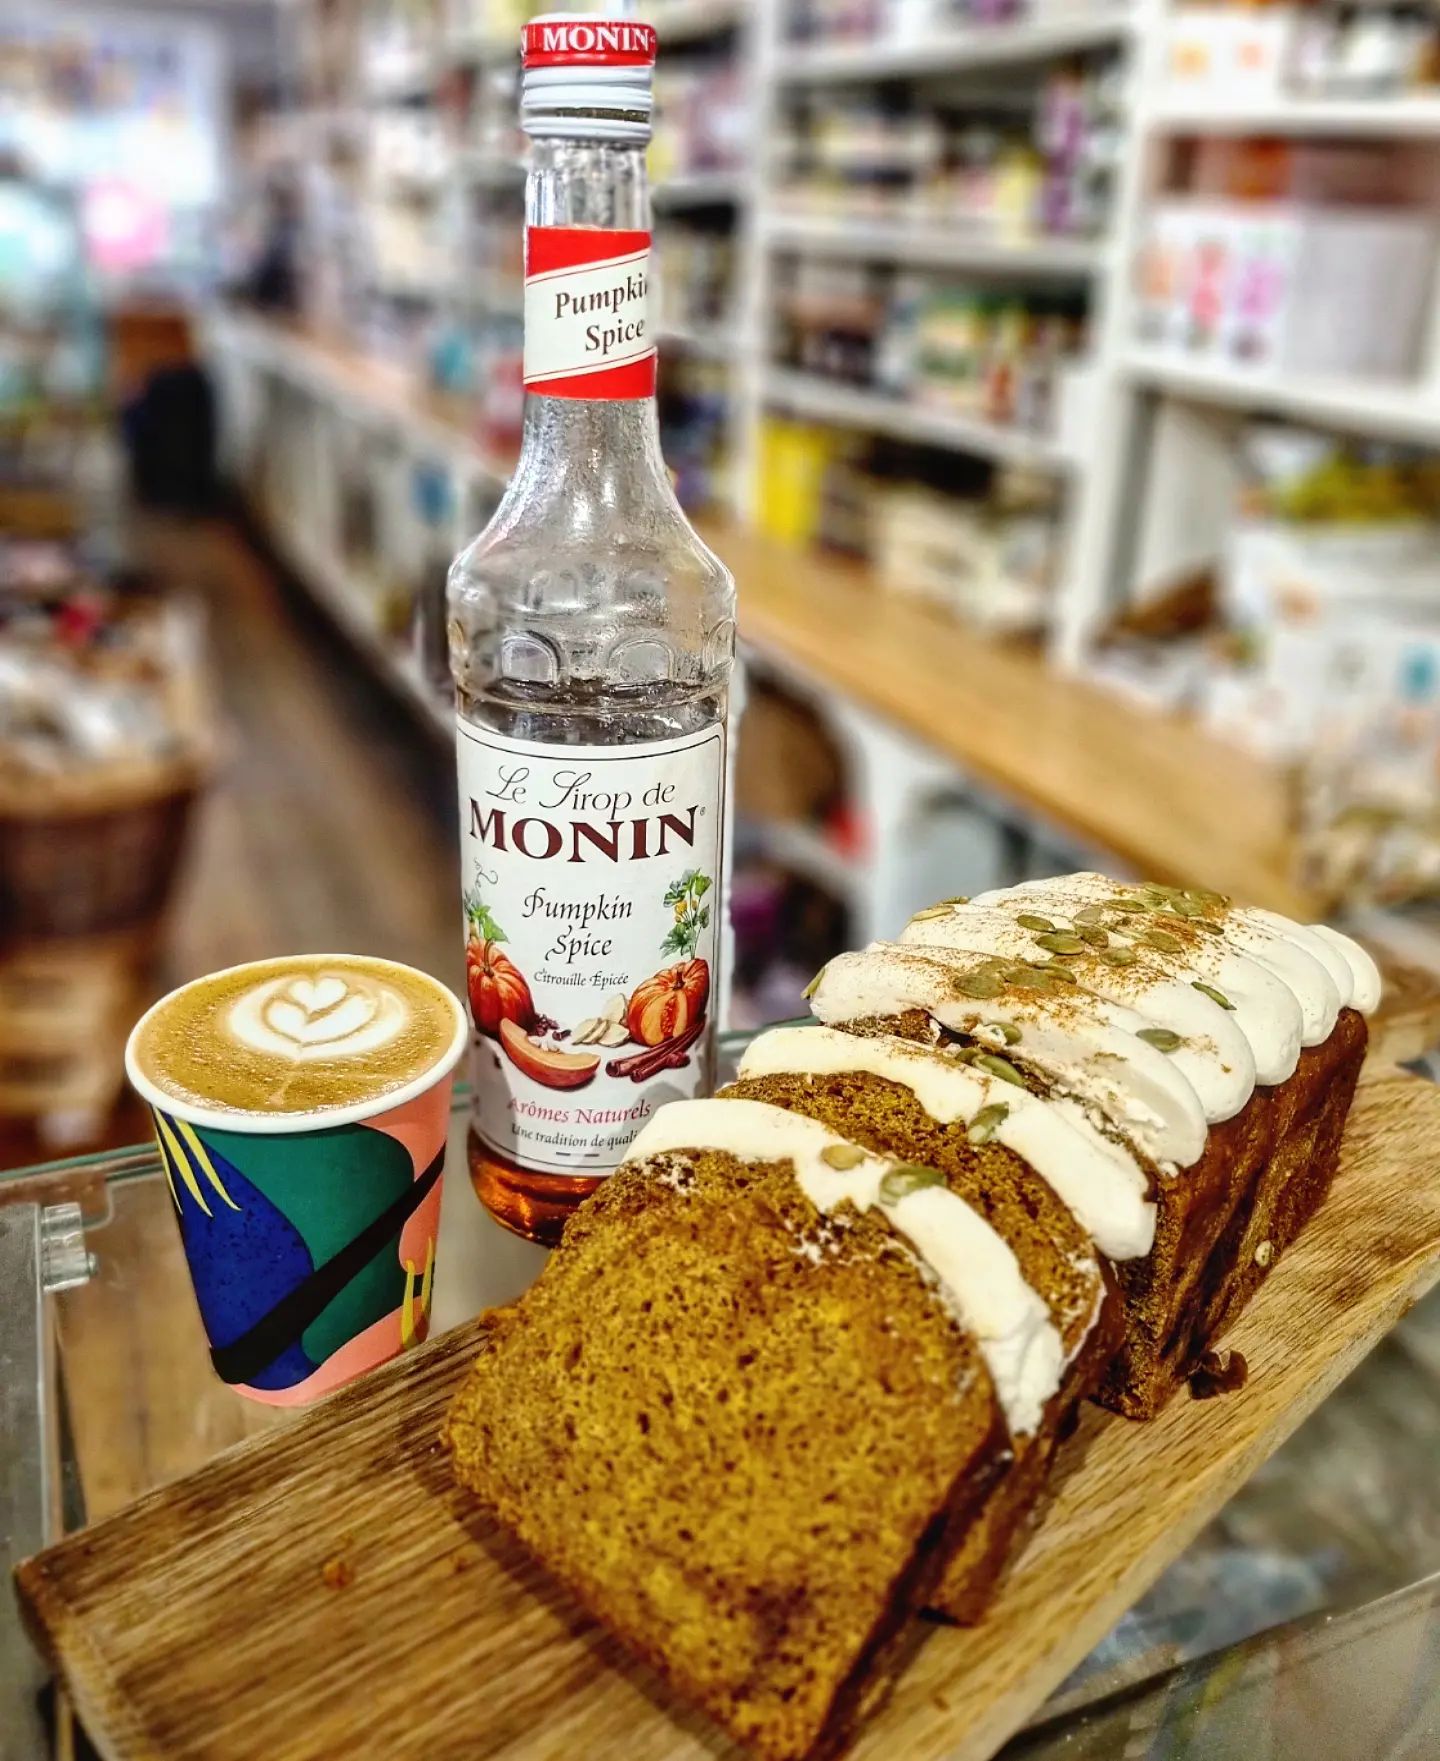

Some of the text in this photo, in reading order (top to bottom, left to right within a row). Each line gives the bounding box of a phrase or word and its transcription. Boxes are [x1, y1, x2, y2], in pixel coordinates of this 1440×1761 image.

[543, 26, 649, 51] MONIN
[585, 318, 645, 355] Spice
[486, 765, 675, 820] Le Sirop de
[469, 796, 699, 863] MONIN
[522, 887, 632, 929] Pumpkin
[545, 925, 612, 963] Spice
[534, 968, 586, 986] Citrouille
[507, 1098, 651, 1124] Arômes Naturels
[511, 1123, 532, 1139] Une
[536, 1131, 587, 1147] tradition
[590, 1134, 605, 1147] de
